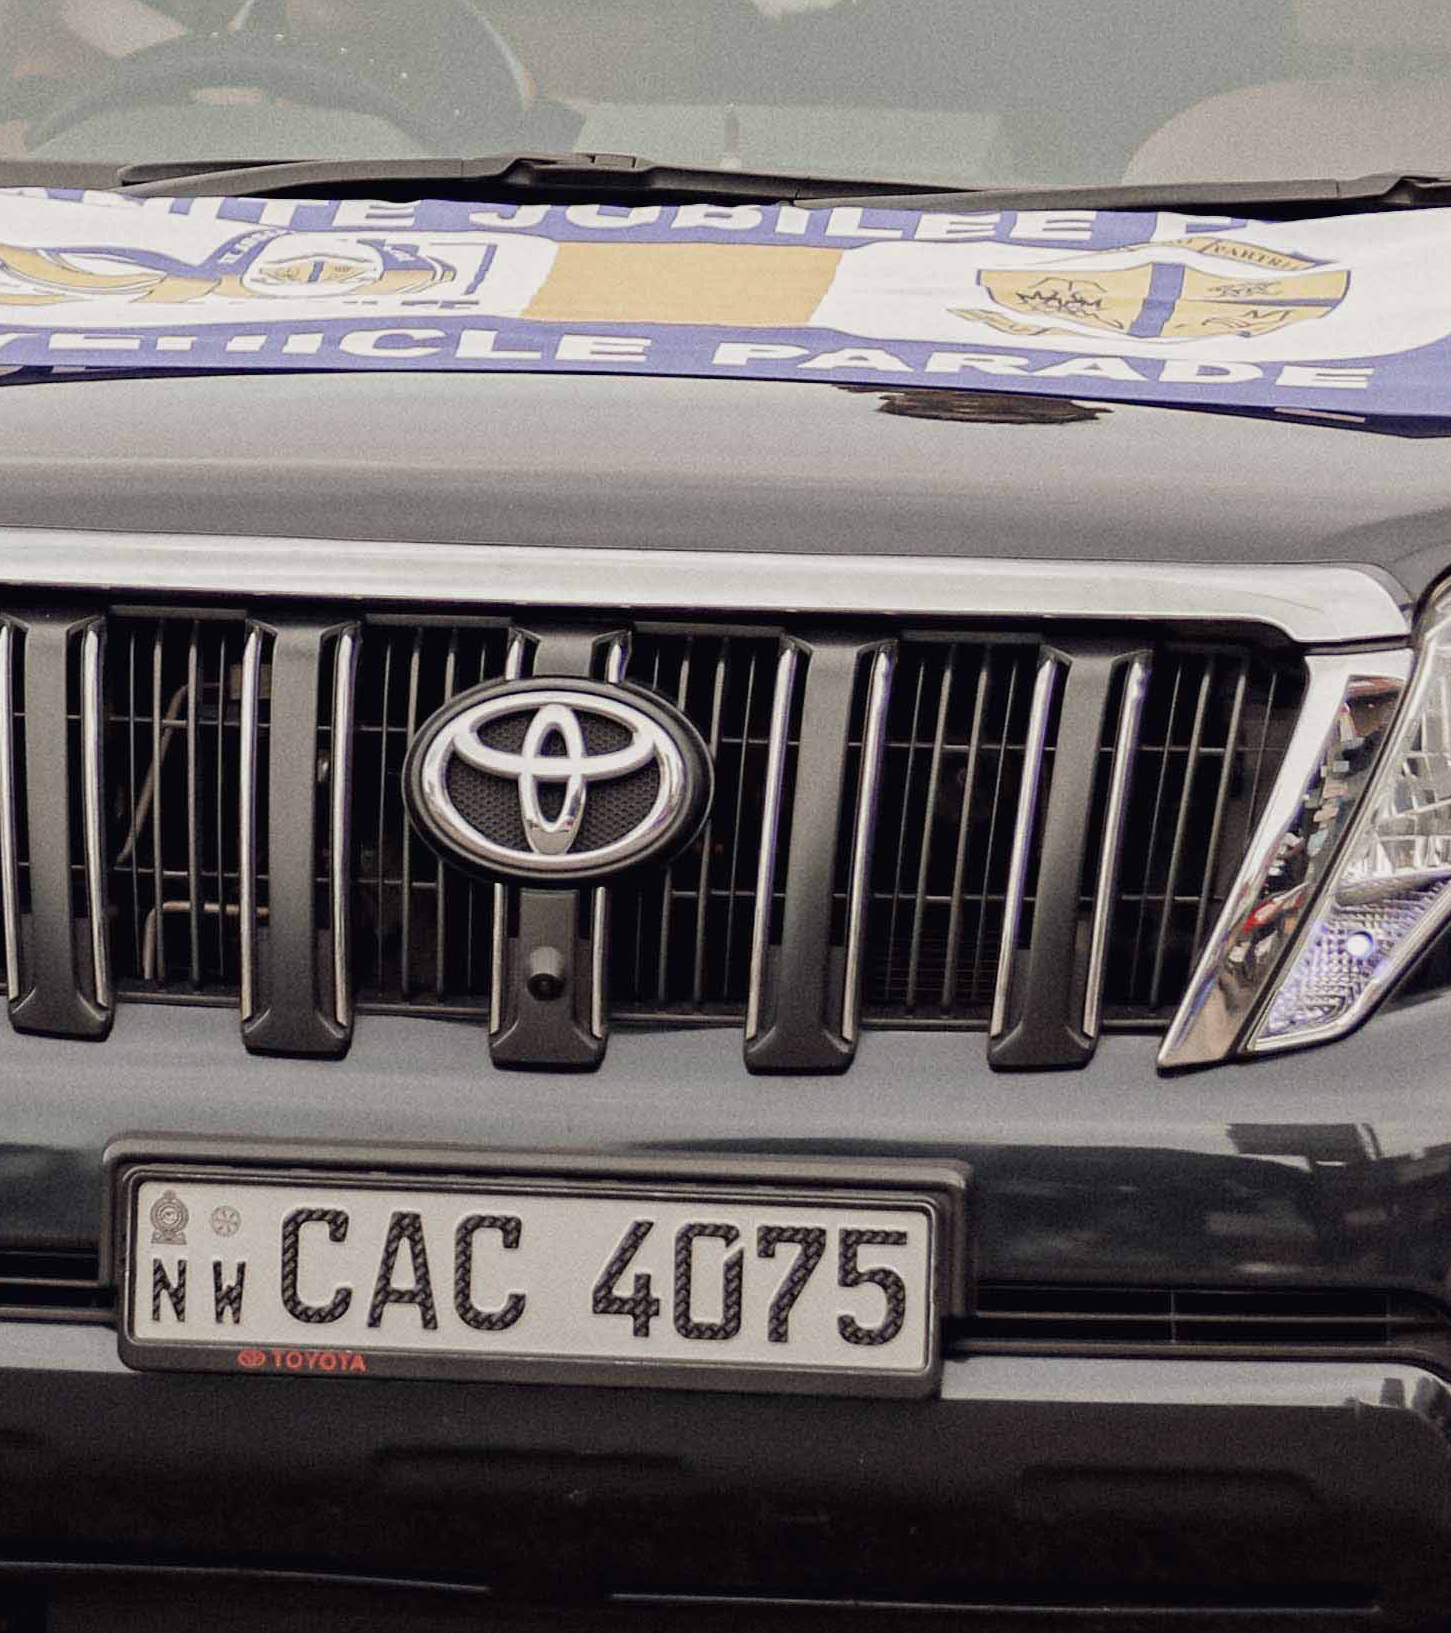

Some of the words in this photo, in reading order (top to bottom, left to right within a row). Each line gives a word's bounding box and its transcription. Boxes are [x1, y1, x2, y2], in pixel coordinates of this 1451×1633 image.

[711, 342, 1375, 390] PARADE
[279, 1206, 527, 1333] CAC
[591, 1219, 909, 1347] 4075
[271, 1348, 367, 1372] TOYOTA
